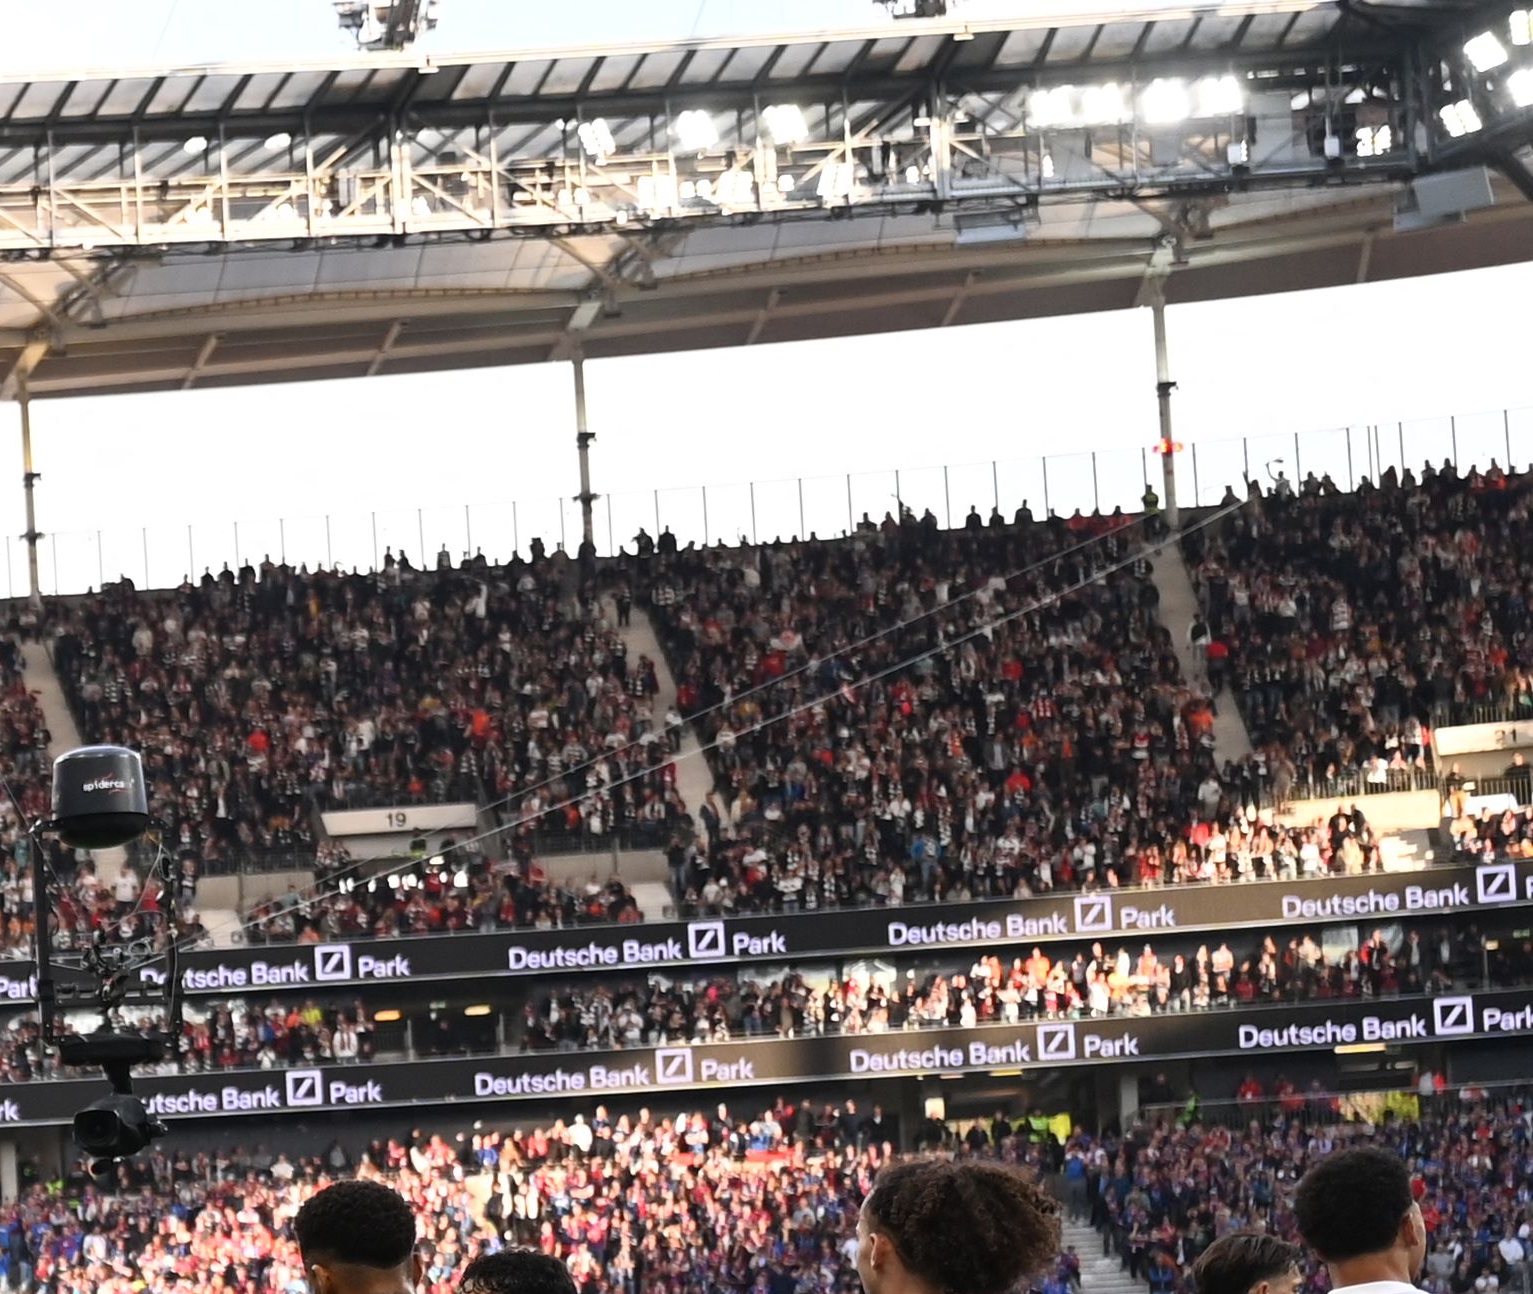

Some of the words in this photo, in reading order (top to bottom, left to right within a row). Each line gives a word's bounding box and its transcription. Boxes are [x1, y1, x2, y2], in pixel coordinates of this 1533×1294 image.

[387, 812, 406, 828] 19
[1281, 890, 1399, 918] Deutsche
[1405, 883, 1469, 908] Bank
[887, 918, 1001, 945] Deutsche
[1006, 914, 1067, 938] Bank
[1120, 905, 1175, 929] Park
[508, 944, 614, 970] Deutsche
[622, 939, 682, 963] Bank
[733, 931, 786, 955] Park
[251, 960, 308, 984] Bank
[358, 956, 411, 978] Park
[1238, 1020, 1356, 1048] Deutsche
[1362, 1014, 1427, 1040] Bank
[850, 1045, 964, 1073] Deutsche
[969, 1041, 1030, 1066] Bank
[1084, 1033, 1139, 1058] Park
[475, 1069, 584, 1096] Deutsche
[589, 1064, 649, 1089] Bank
[701, 1057, 753, 1081] Park
[222, 1085, 280, 1109] Bank
[330, 1080, 382, 1103] Park
